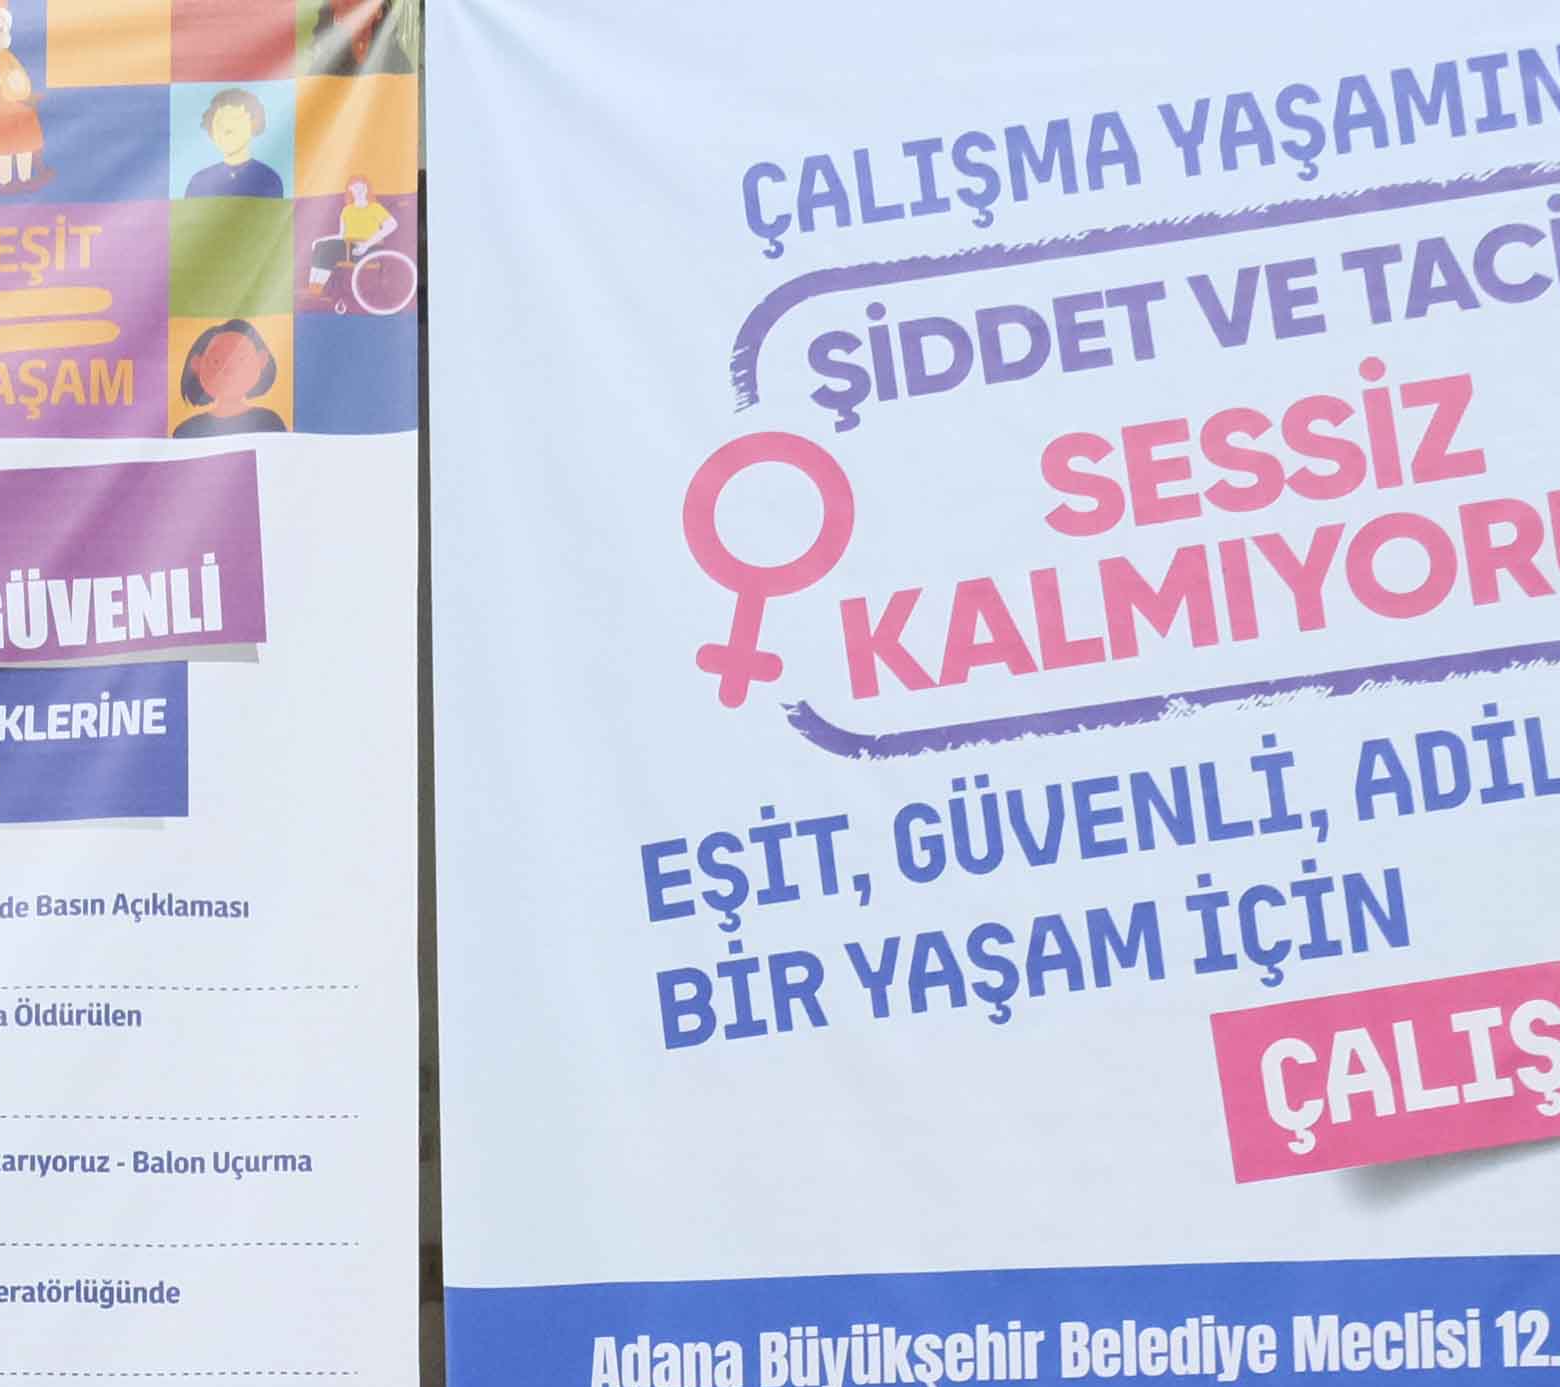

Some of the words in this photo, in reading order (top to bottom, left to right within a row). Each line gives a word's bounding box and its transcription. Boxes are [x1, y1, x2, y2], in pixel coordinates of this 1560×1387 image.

[742, 111, 1142, 259] ÇALIŞMA
[807, 281, 1167, 433] ŞİDDET
[1187, 258, 1326, 348] VE
[1040, 356, 1486, 536] SESSİZ
[36, 894, 106, 917] Basın
[111, 892, 250, 924] Açıklaması
[640, 805, 872, 932] EŞİT,
[893, 733, 1329, 885] GÜVENLİ,
[657, 940, 829, 1050] BİR
[845, 900, 1165, 1025] YAŞAM
[1186, 859, 1411, 985] İÇİN
[1059, 1314, 1278, 1383] Belediye
[1292, 1307, 1482, 1373] Meclisi
